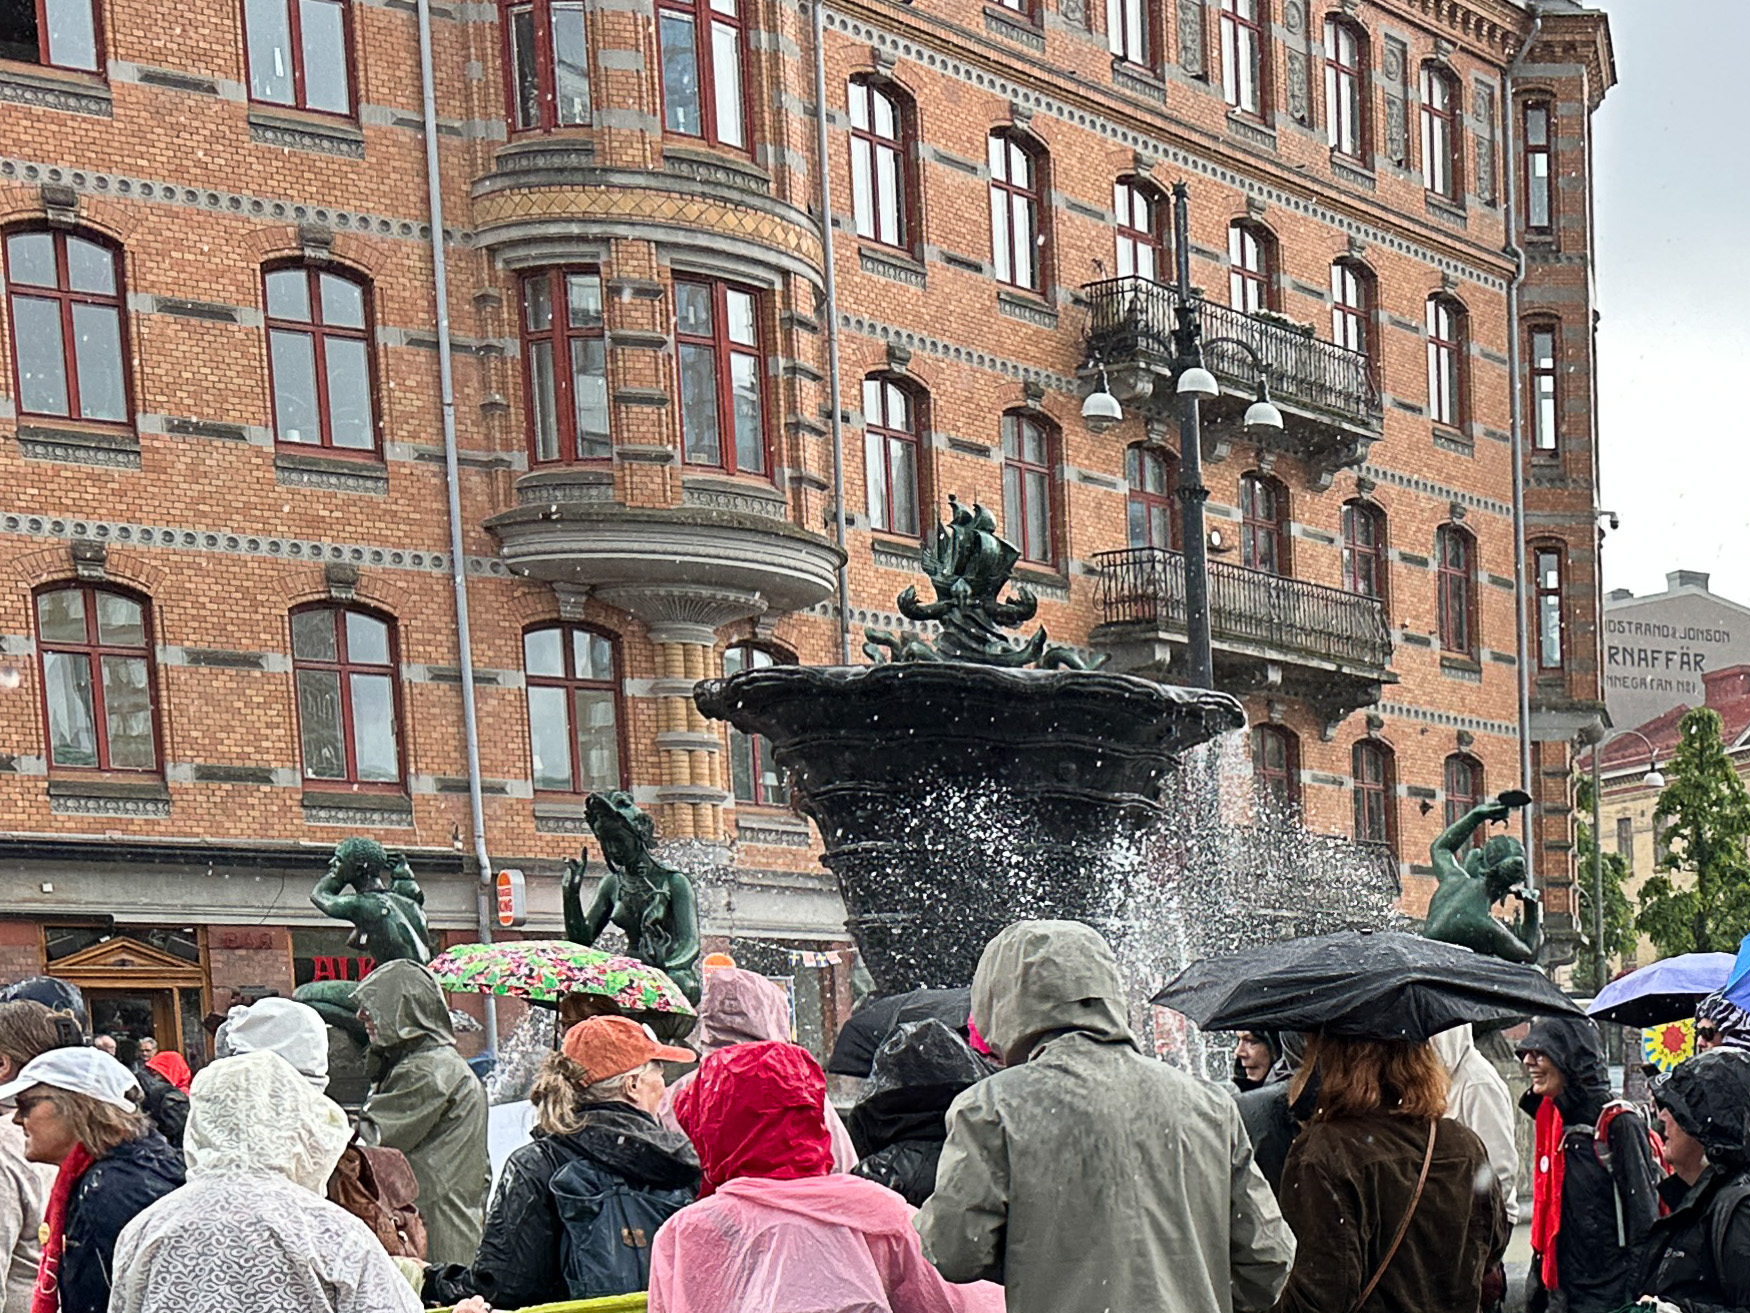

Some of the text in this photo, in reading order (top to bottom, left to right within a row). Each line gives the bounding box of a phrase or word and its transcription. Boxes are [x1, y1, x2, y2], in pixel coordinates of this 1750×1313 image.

[1679, 627, 1731, 643] JONSON
[1607, 645, 1706, 672] RNAFFÄR
[223, 932, 274, 950] BAR
